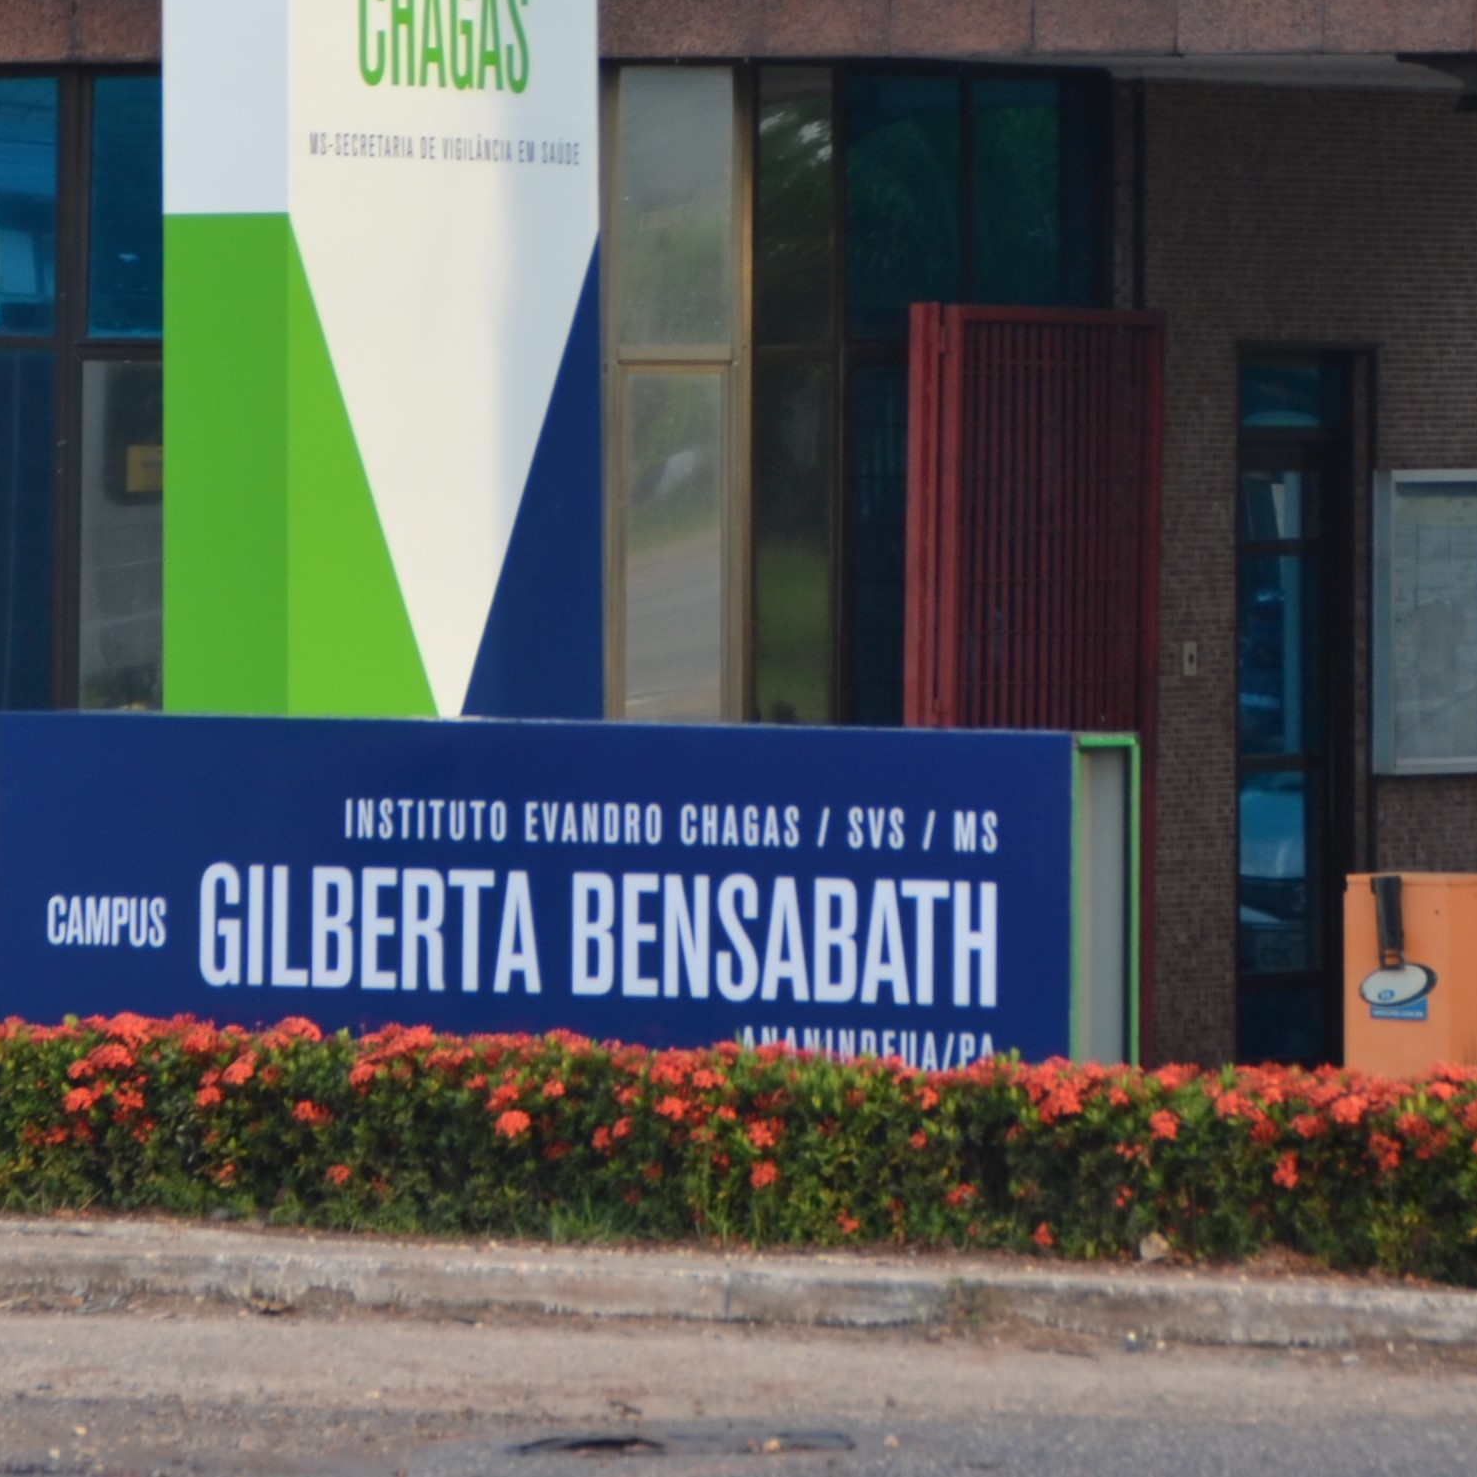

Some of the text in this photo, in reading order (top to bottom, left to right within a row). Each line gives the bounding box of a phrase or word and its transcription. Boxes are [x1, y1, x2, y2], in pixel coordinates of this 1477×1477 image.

[420, 136, 436, 160] DE
[442, 134, 513, 163] VIGILÂNCIA
[518, 139, 535, 163] EM
[541, 137, 581, 166] SAÚDE
[344, 797, 998, 853] INSTITUTO EVANDRO CHAGAS / SVS / MS
[47, 861, 998, 1008] CAMPUS GILBERTA BENSABATH
